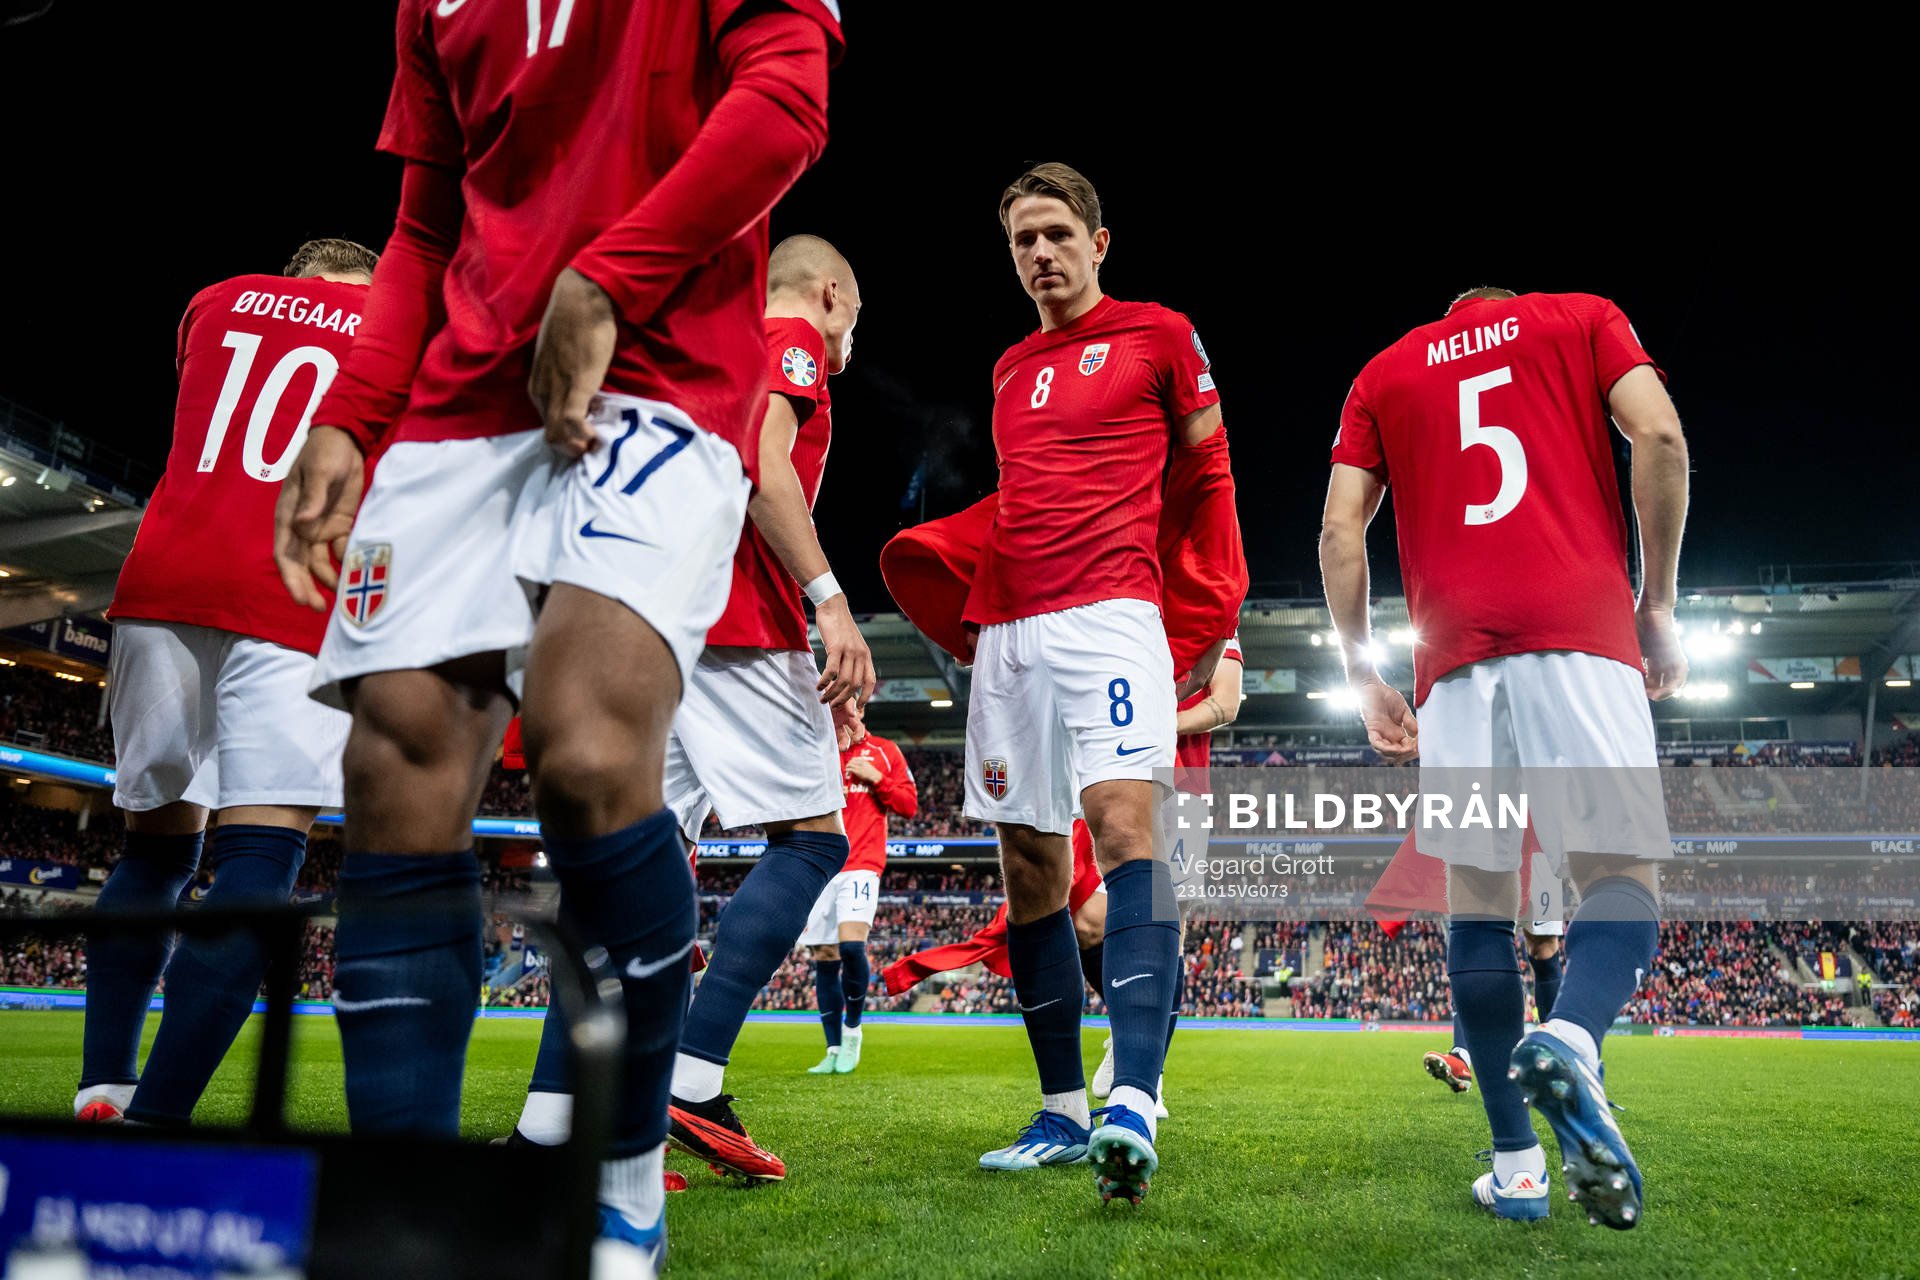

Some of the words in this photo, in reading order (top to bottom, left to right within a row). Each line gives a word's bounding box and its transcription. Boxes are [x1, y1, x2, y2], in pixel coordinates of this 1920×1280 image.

[231, 290, 362, 337] ØDEGAAR
[1427, 316, 1520, 367] MELING
[197, 330, 340, 483] 10
[1030, 366, 1055, 409] 8
[592, 408, 696, 496] 17
[1458, 365, 1529, 526] 5
[63, 625, 108, 653] bama
[1107, 677, 1134, 727] 8
[1245, 842, 1284, 855] PEACE
[1871, 841, 1914, 854] PEACE
[853, 881, 870, 900] 14
[1540, 891, 1550, 916] 9
